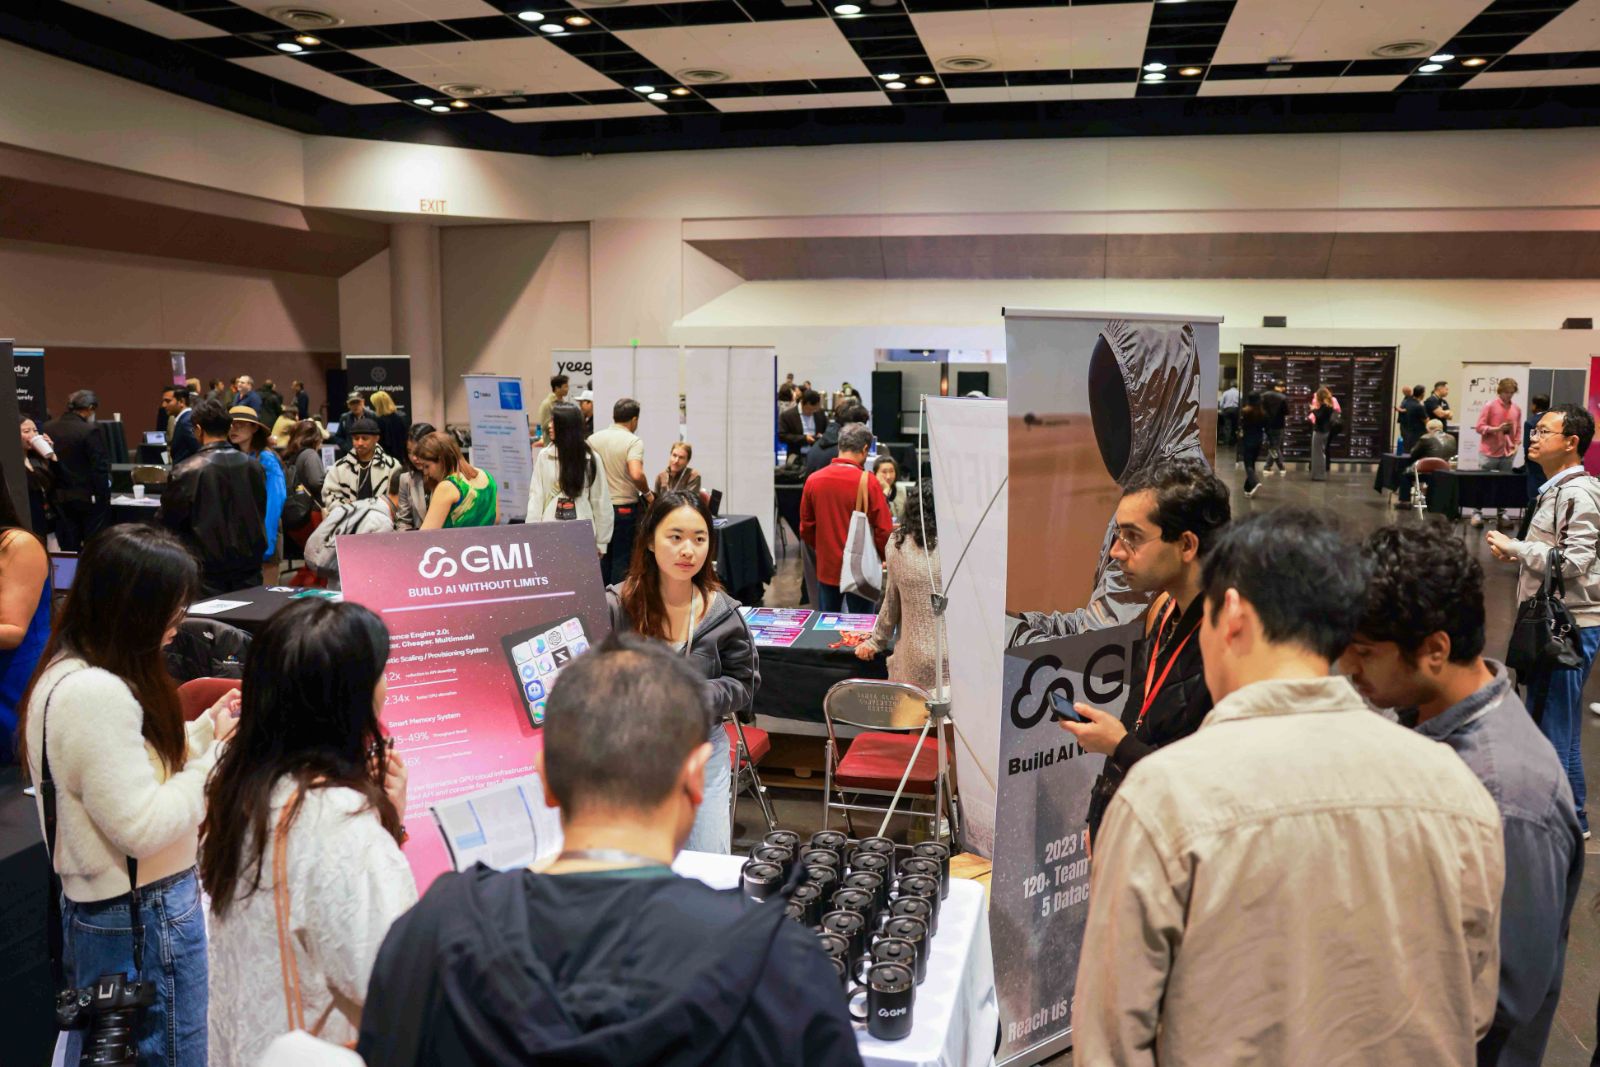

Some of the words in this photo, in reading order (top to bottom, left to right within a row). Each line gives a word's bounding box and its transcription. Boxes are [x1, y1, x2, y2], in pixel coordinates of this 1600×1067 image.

[420, 199, 447, 212] EXIT
[461, 543, 533, 573] GMI
[408, 586, 443, 598] BUILD
[445, 585, 457, 595] AI
[458, 579, 511, 593] WITHOUT
[513, 576, 549, 588] LIMITS
[401, 639, 434, 649] Cheaper.
[435, 634, 475, 645] Multimodal
[410, 630, 436, 641] Engine
[436, 628, 450, 636] 2.0:
[400, 653, 424, 664] Scaling
[428, 649, 465, 660] Provisioning
[466, 647, 489, 657] System
[387, 720, 408, 728] Smart
[409, 716, 436, 726] Memory
[437, 712, 461, 722] System
[1008, 748, 1054, 775] Build
[1057, 742, 1074, 763] AI
[1045, 834, 1078, 864] 2023
[1022, 872, 1051, 899] 120+
[1054, 858, 1089, 887] Team
[1041, 895, 1051, 917] 5
[889, 1007, 906, 1017] GMI
[1008, 1007, 1049, 1043] Reach
[1051, 999, 1068, 1021] us
